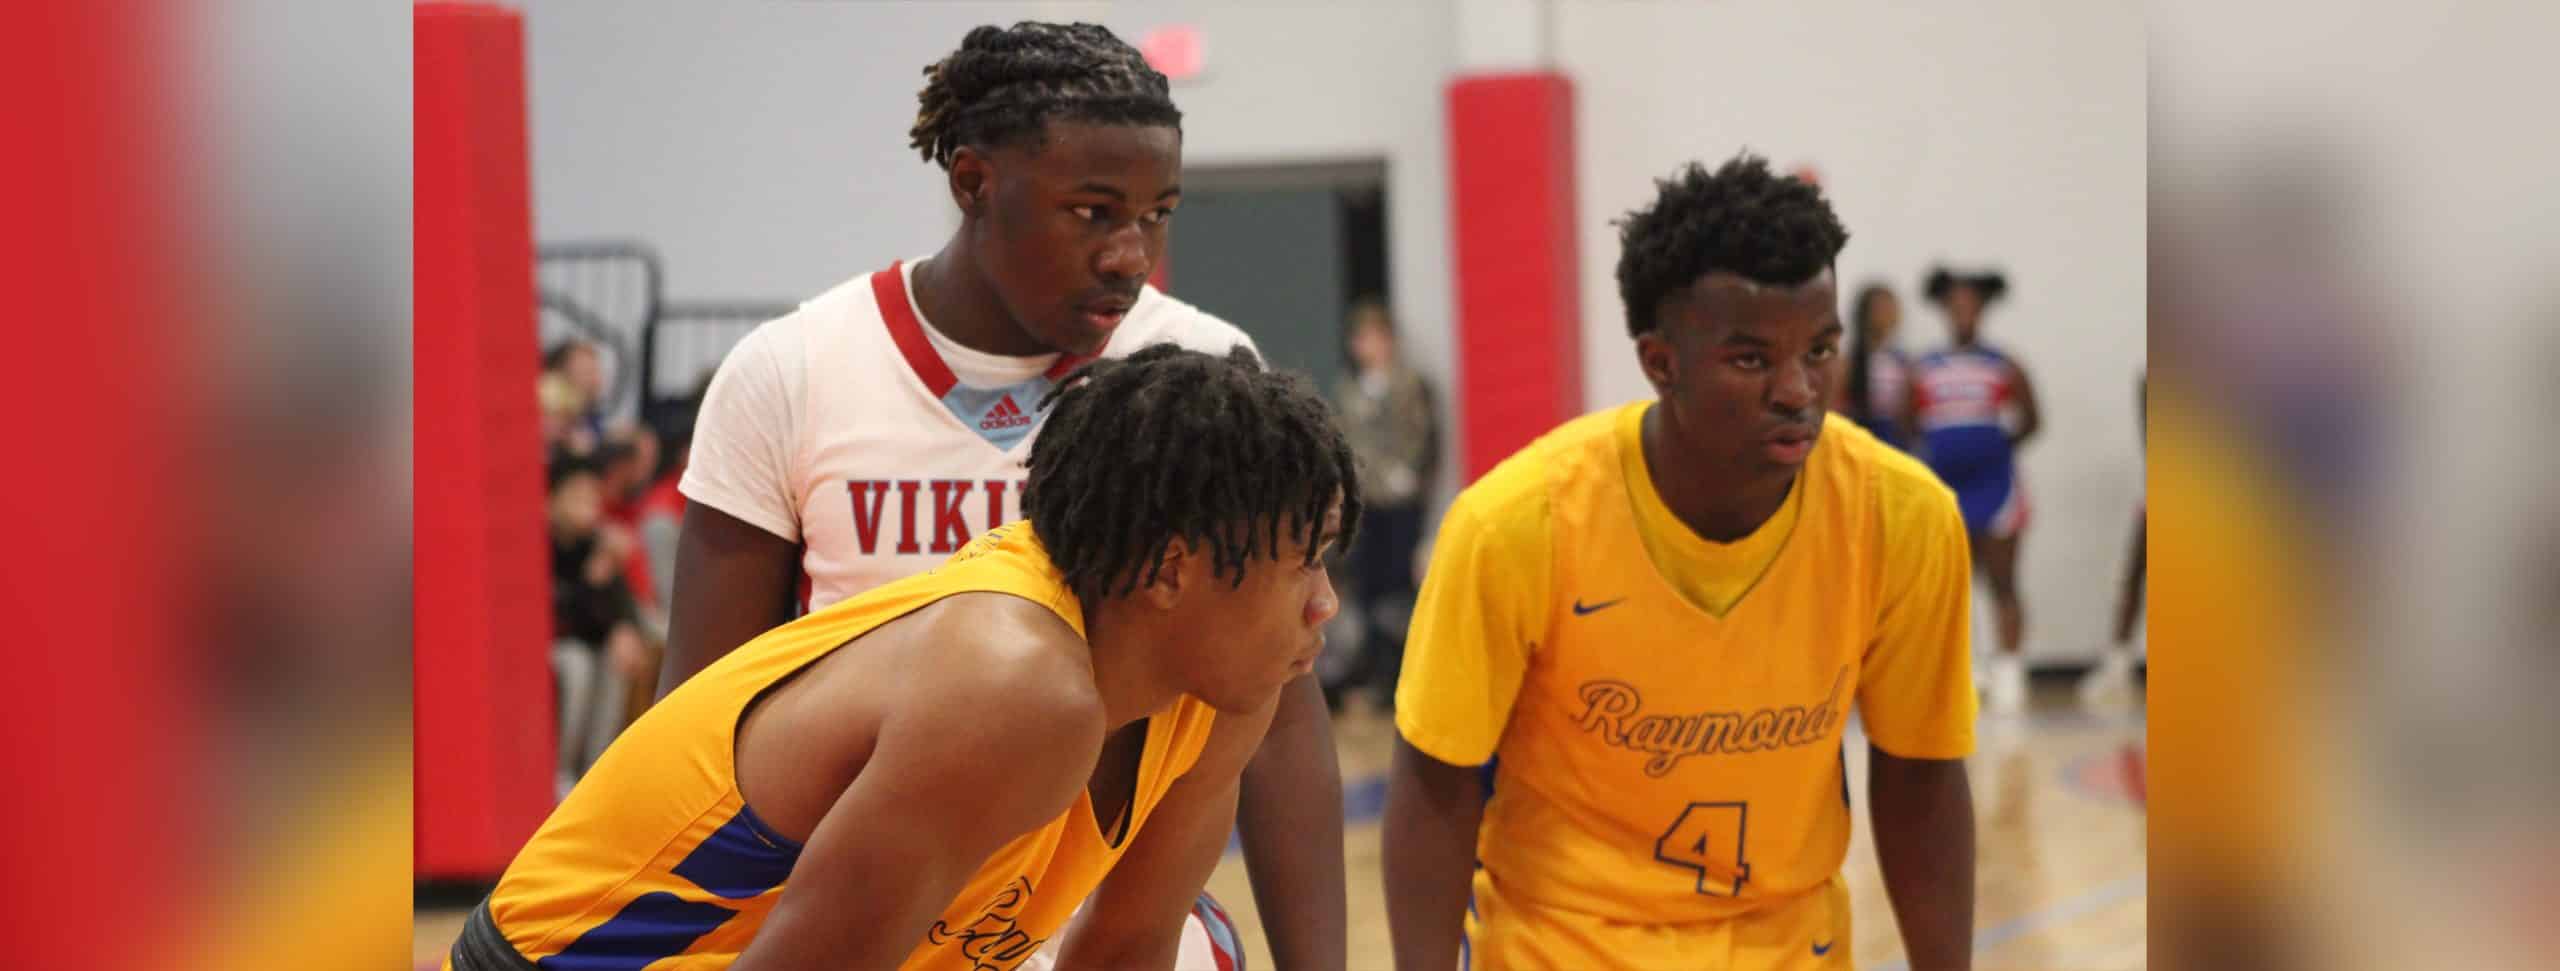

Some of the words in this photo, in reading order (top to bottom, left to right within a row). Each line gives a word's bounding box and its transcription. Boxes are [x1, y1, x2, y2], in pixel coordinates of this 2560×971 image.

[980, 415, 1032, 430] adidas
[847, 480, 1028, 555] VIKI
[1570, 664, 1848, 778] Raymond
[1655, 801, 1750, 897] 4
